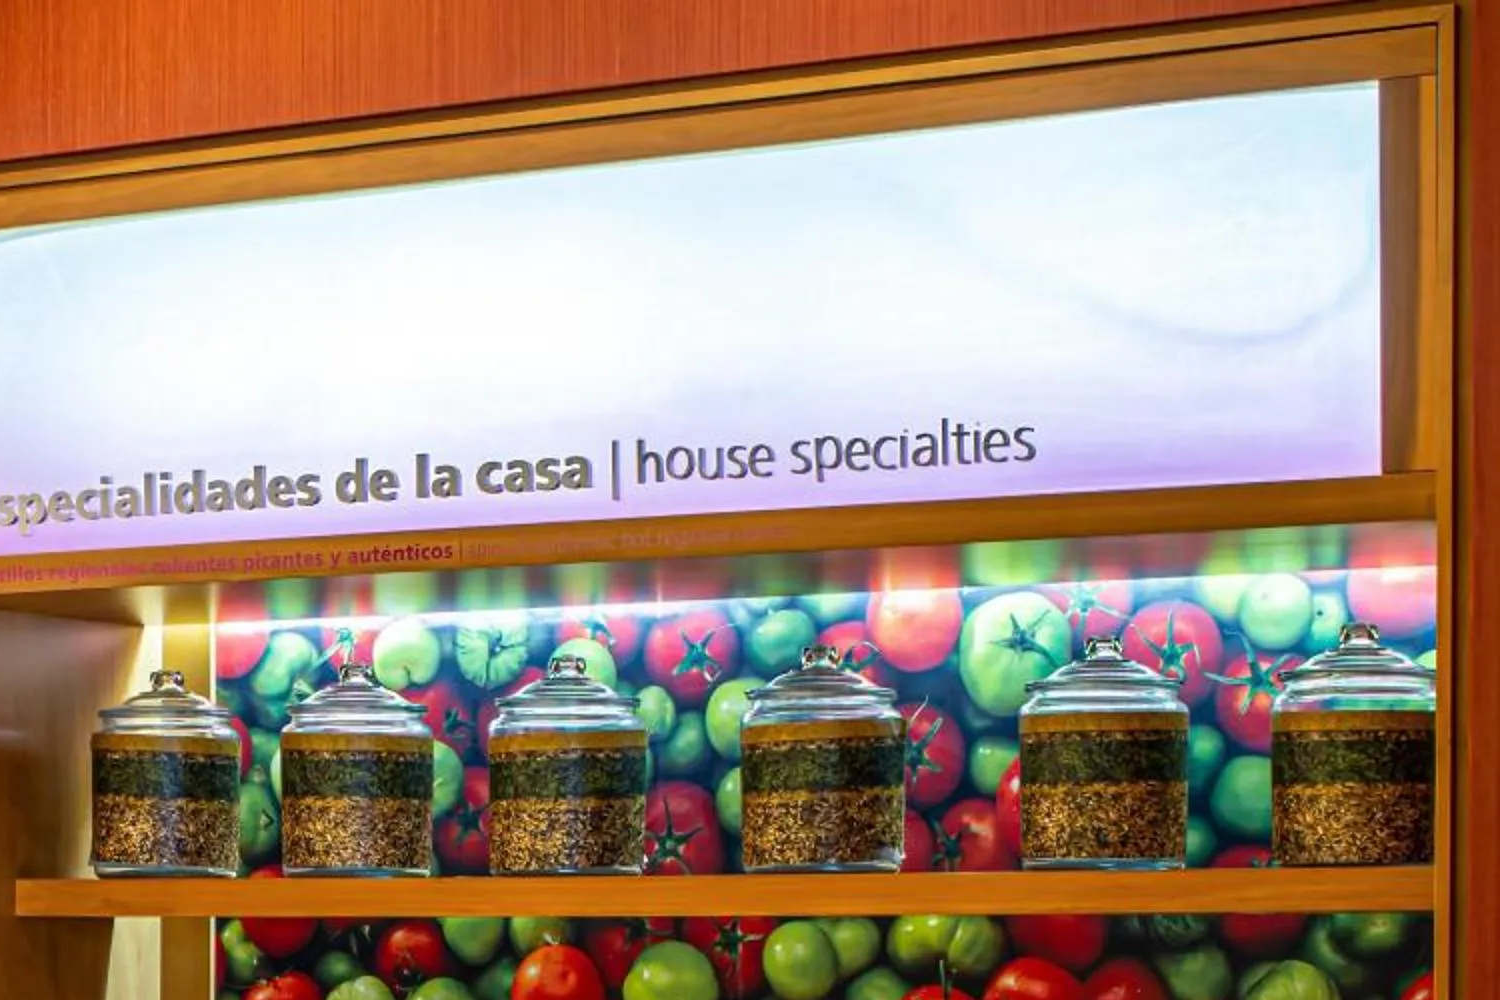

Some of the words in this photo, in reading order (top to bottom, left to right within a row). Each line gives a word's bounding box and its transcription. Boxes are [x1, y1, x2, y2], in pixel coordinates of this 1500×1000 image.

[335, 457, 400, 504] de
[415, 453, 462, 499] la
[476, 455, 593, 494] casa
[636, 438, 776, 484] house
[790, 418, 1037, 483] specialties
[244, 549, 322, 573] picantes
[330, 549, 341, 569] y
[350, 541, 453, 564] auténticos
